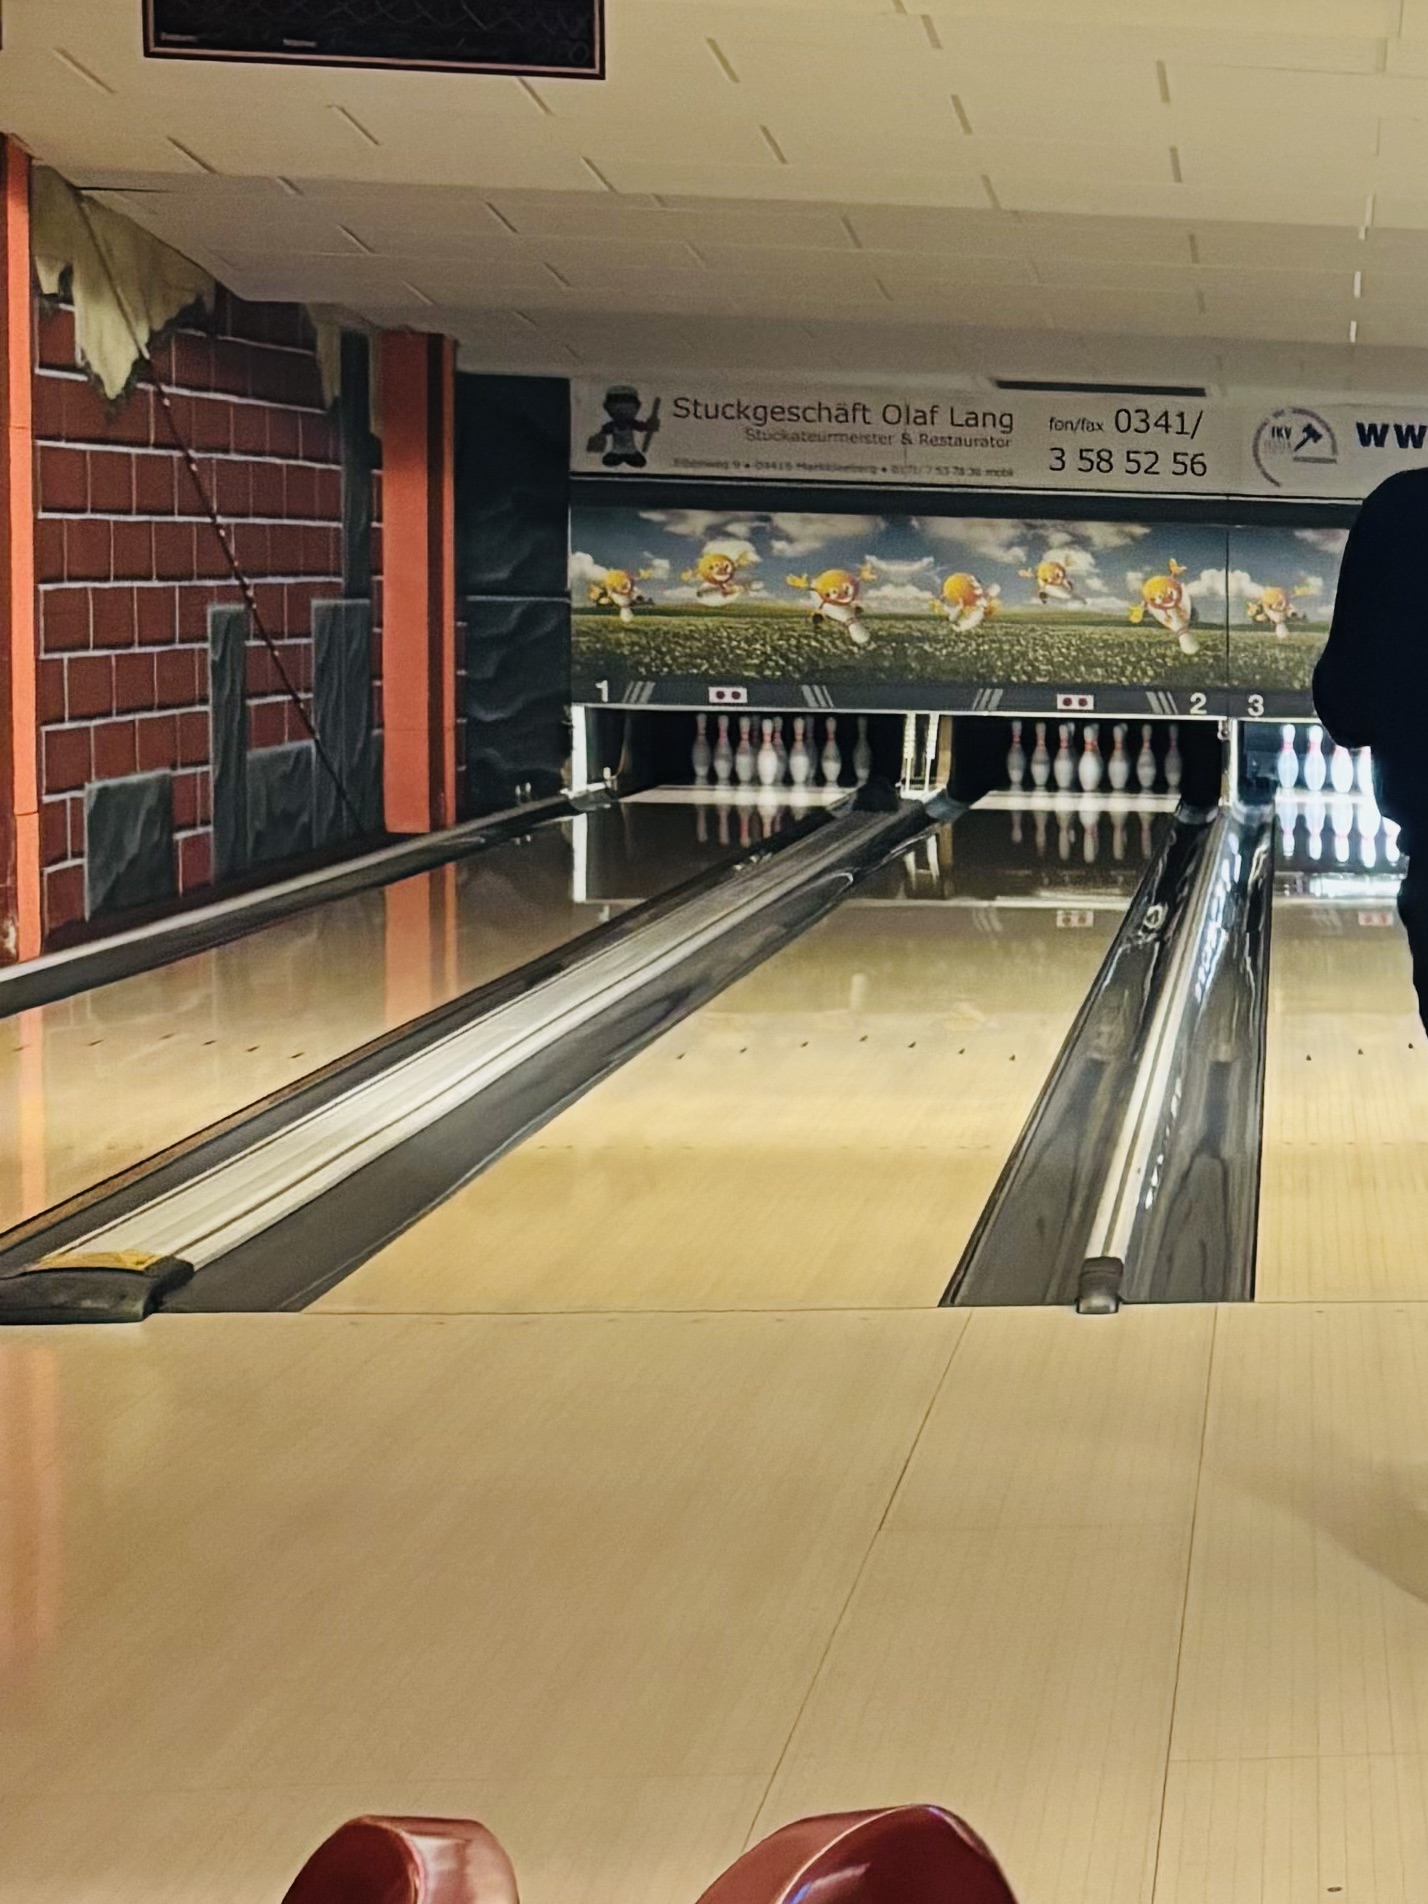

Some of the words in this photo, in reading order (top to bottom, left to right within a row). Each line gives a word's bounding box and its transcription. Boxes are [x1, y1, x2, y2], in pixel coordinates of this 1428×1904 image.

[672, 397, 871, 429] Stuckgeschäft
[882, 402, 939, 426] Olaf
[951, 406, 1014, 434] Lang
[1049, 416, 1104, 434] fon/fax
[1114, 408, 1205, 438] 0341/
[745, 427, 893, 447] Stuckateurmeister
[901, 431, 913, 446] &
[919, 432, 1012, 449] Restaurator
[1049, 446, 1066, 471] 3
[1077, 447, 1114, 473] 58
[1125, 449, 1161, 476] 52
[1172, 451, 1208, 478] 56
[596, 681, 608, 703] 1
[1189, 692, 1207, 715] 2
[1247, 694, 1265, 717] 3
